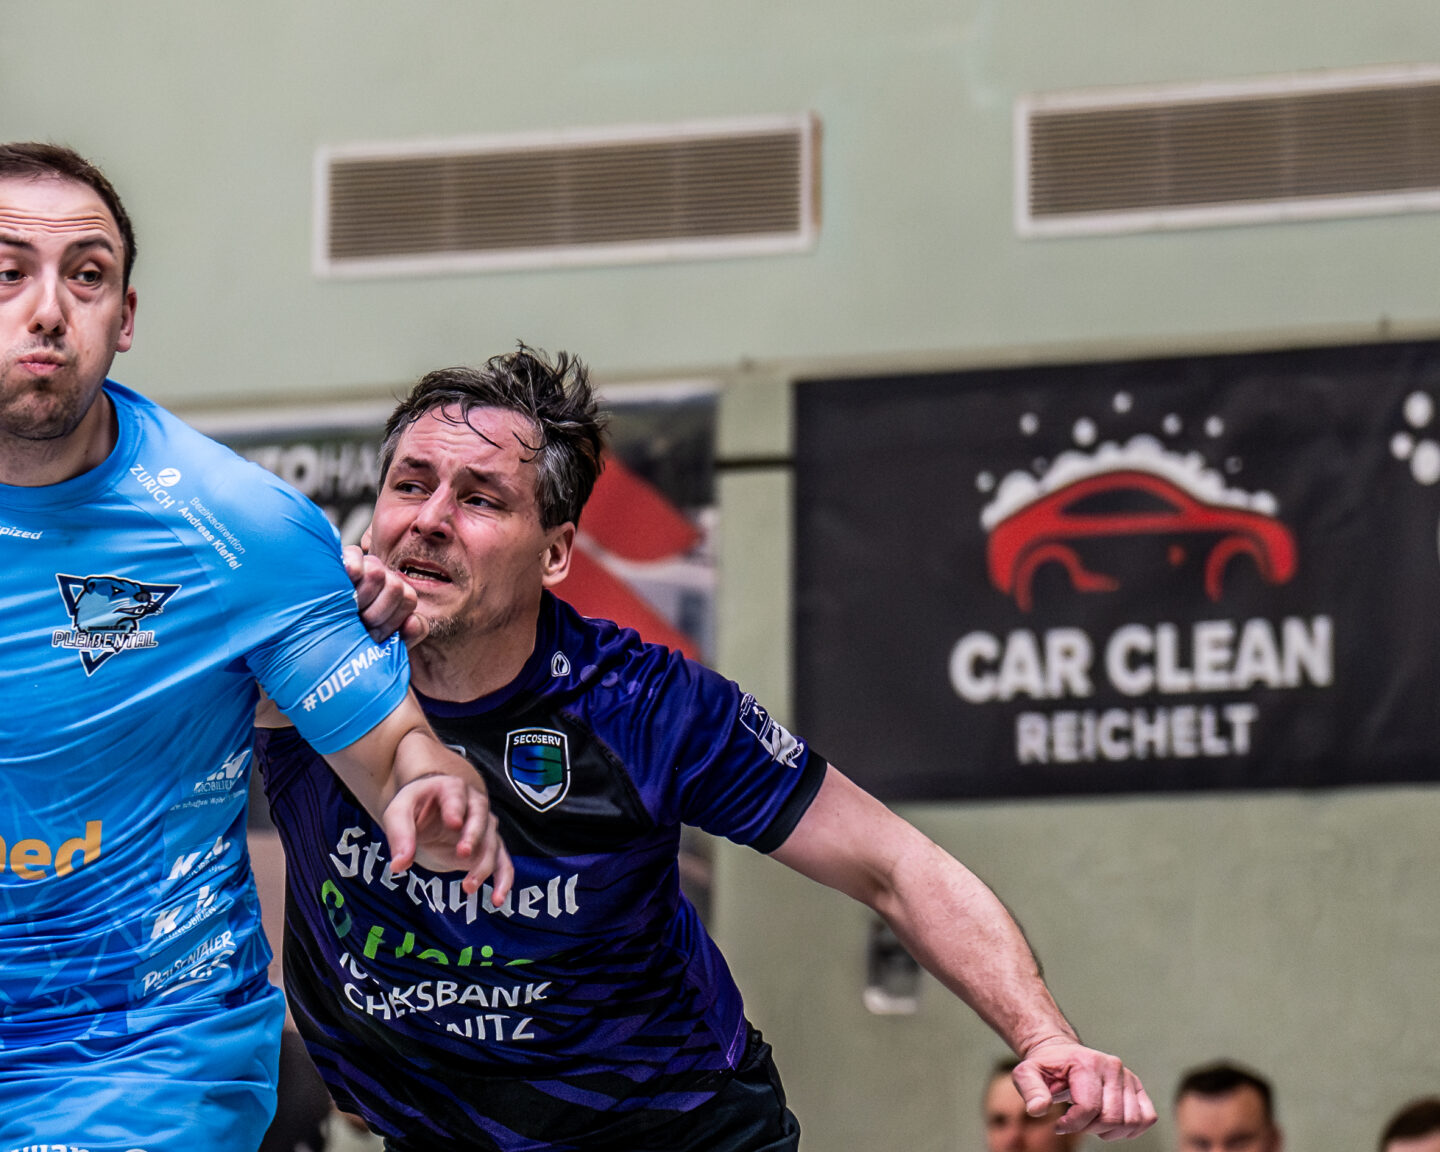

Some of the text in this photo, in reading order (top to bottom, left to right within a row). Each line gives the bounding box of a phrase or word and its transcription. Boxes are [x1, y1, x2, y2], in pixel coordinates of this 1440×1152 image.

[129, 463, 176, 509] ZURICH
[178, 507, 243, 570] Andreas Kleffel
[950, 616, 1334, 703] CAR CLEAN
[513, 734, 561, 747] SECOSERV
[1016, 704, 1258, 764] REICHELT
[340, 952, 552, 1014] OKSBANK
